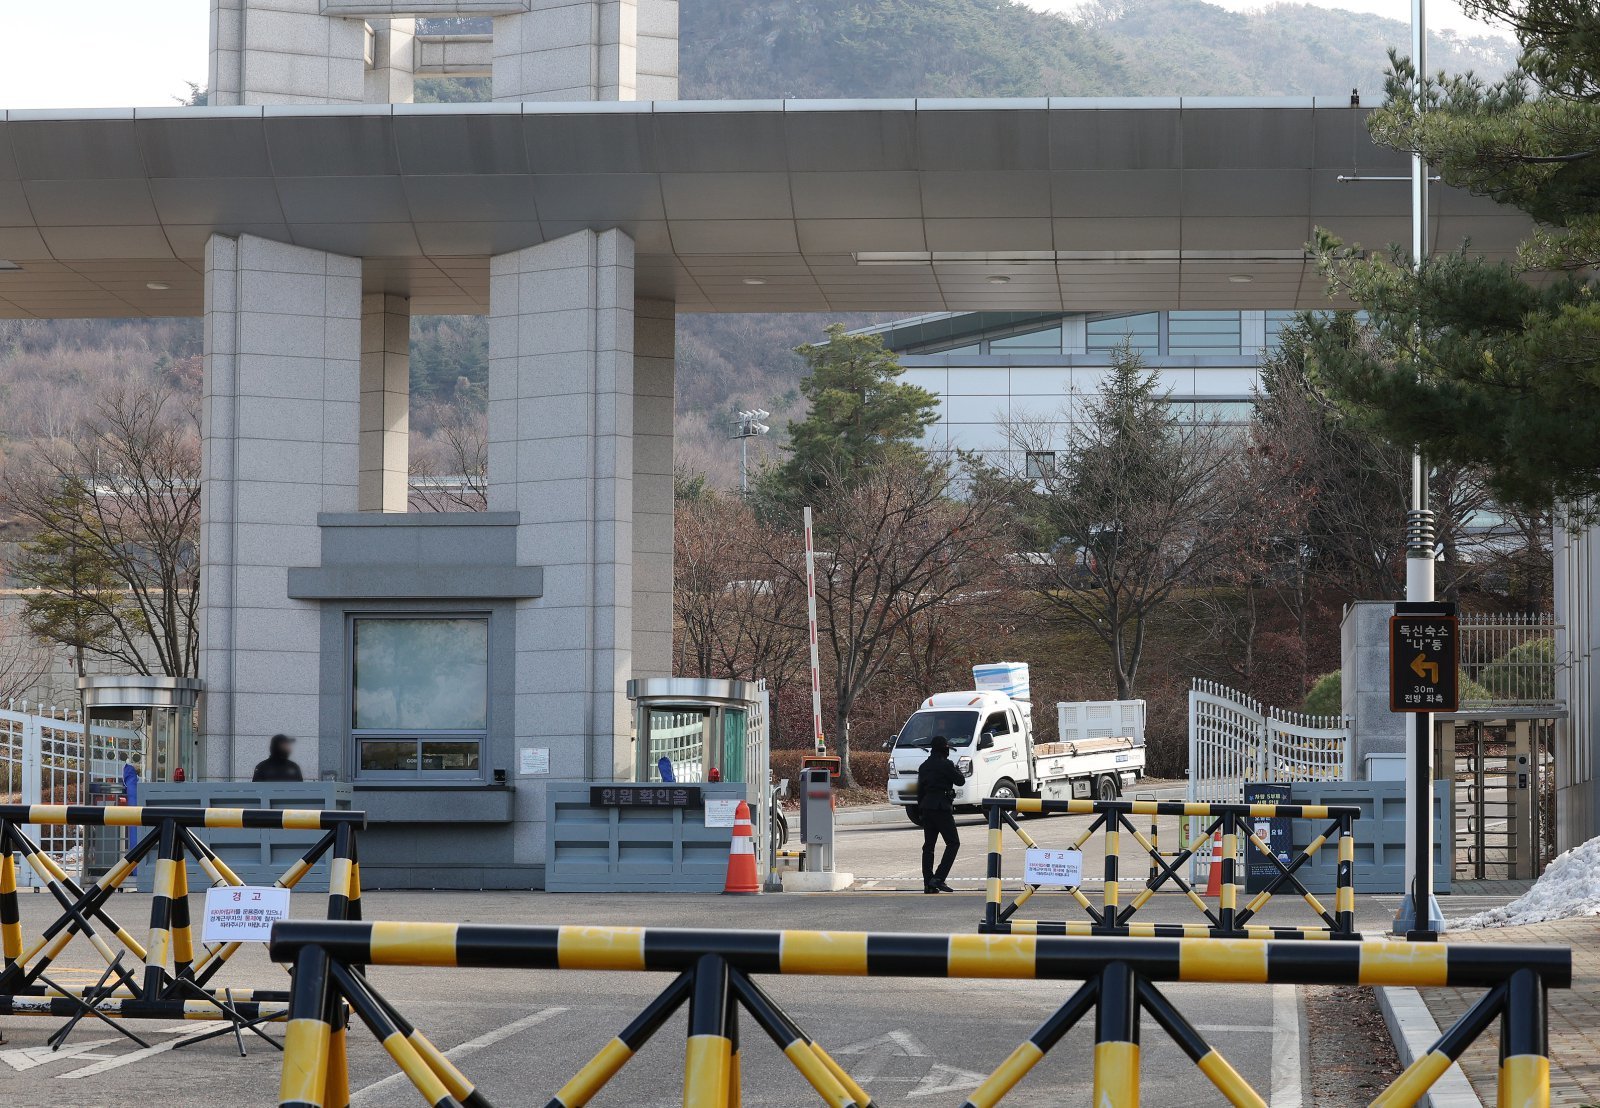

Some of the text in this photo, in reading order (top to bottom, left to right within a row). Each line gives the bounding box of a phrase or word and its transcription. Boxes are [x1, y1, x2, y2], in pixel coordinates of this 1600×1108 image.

[1399, 625, 1449, 637] 독신숙소
[1406, 639, 1443, 651] "나"동
[1414, 685, 1434, 693] 30m
[1404, 694, 1444, 703] 전방 좌측
[602, 788, 688, 805] 인원 확인을
